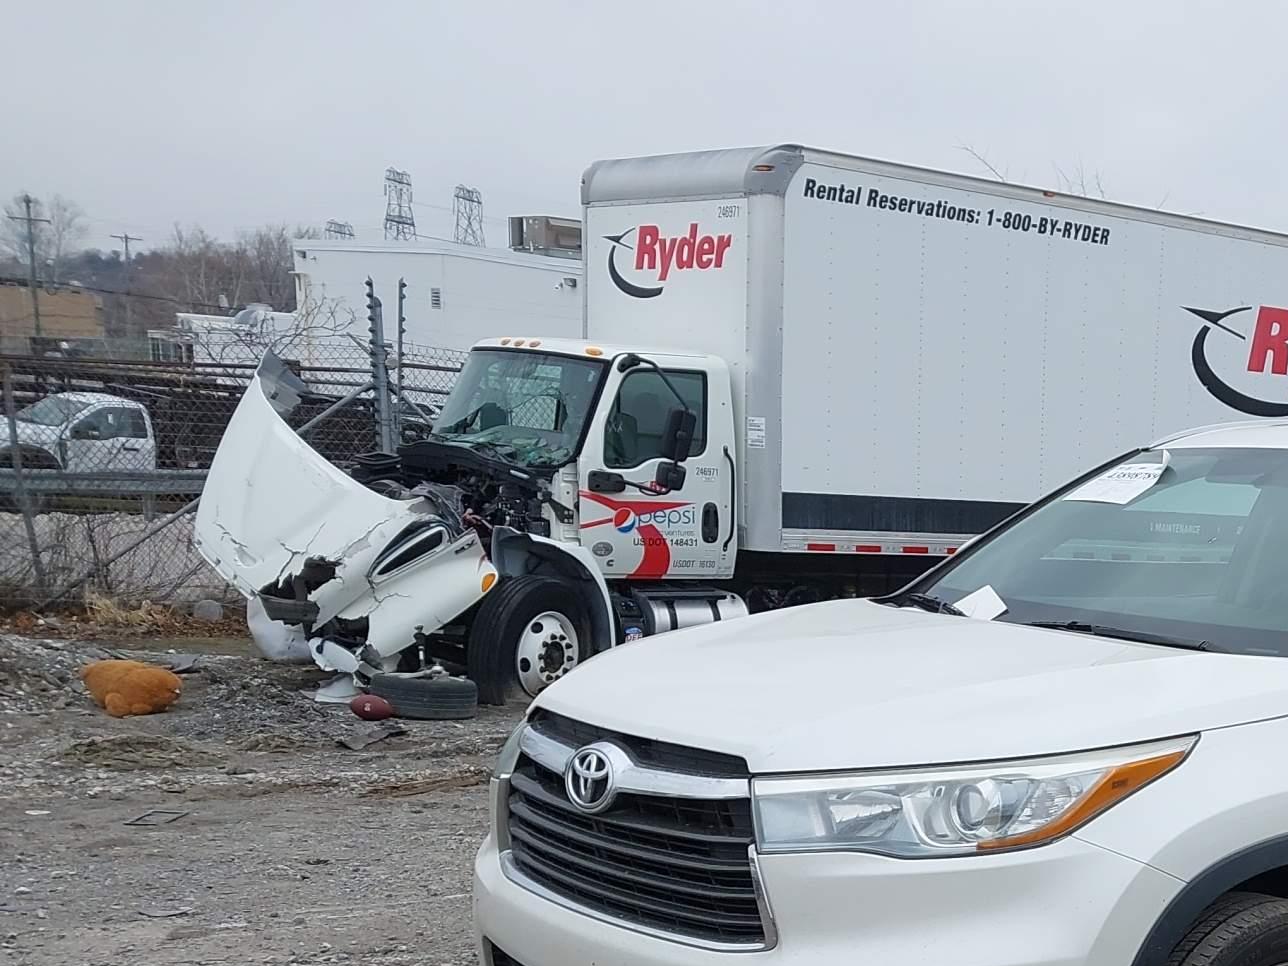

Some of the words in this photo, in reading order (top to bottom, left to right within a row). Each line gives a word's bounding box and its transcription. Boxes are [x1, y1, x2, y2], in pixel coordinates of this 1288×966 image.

[717, 206, 740, 218] 246971
[803, 178, 862, 205] Rental
[866, 188, 982, 225] Reservations:
[986, 208, 1111, 246] 1-800-BY-RYDER
[635, 223, 732, 281] Ryder
[696, 467, 719, 477] 246971
[638, 506, 696, 528] pepsi
[633, 537, 647, 547] US
[648, 537, 668, 547] DOT
[670, 538, 698, 547] 148431
[673, 560, 696, 569] USDOT
